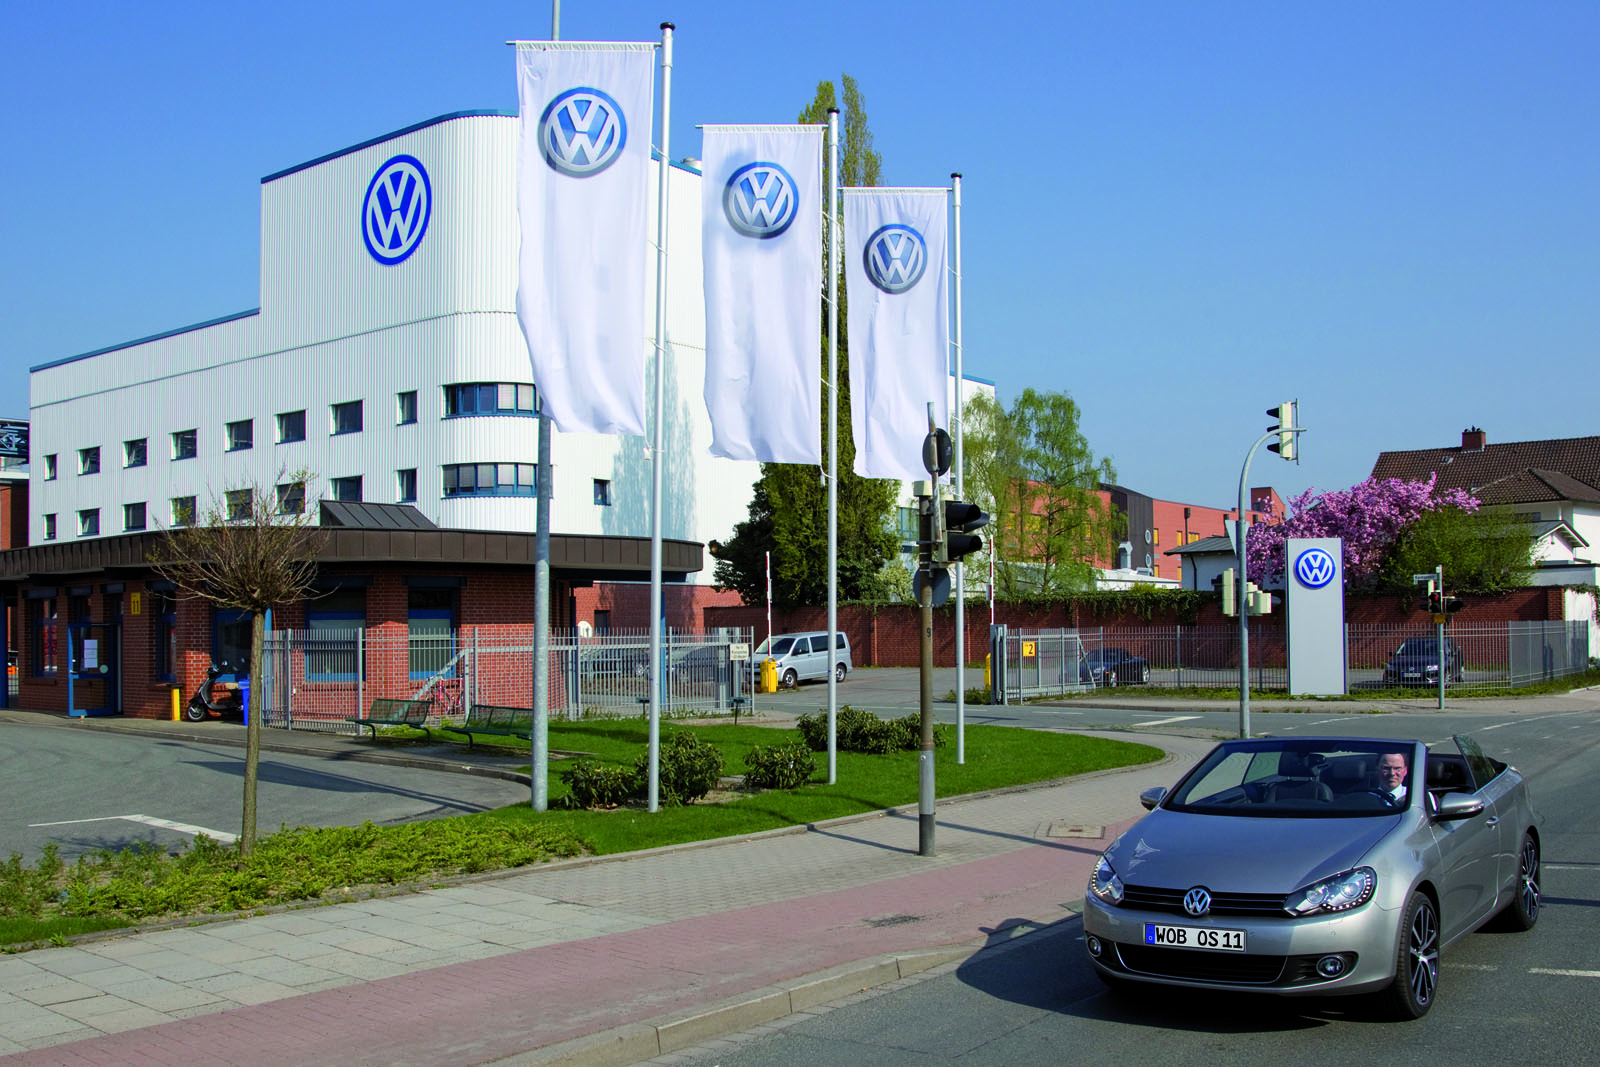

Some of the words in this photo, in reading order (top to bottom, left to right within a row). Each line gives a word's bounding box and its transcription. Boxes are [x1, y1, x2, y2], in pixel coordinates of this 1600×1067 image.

[546, 95, 619, 170] VW
[369, 166, 424, 254] VW
[731, 169, 791, 230] VW
[870, 232, 921, 286] VW
[1300, 553, 1331, 583] VW
[132, 600, 139, 613] 11
[1028, 643, 1034, 655] 2
[1185, 889, 1209, 914] VW
[1155, 927, 1187, 944] WOB
[1197, 930, 1219, 947] OS
